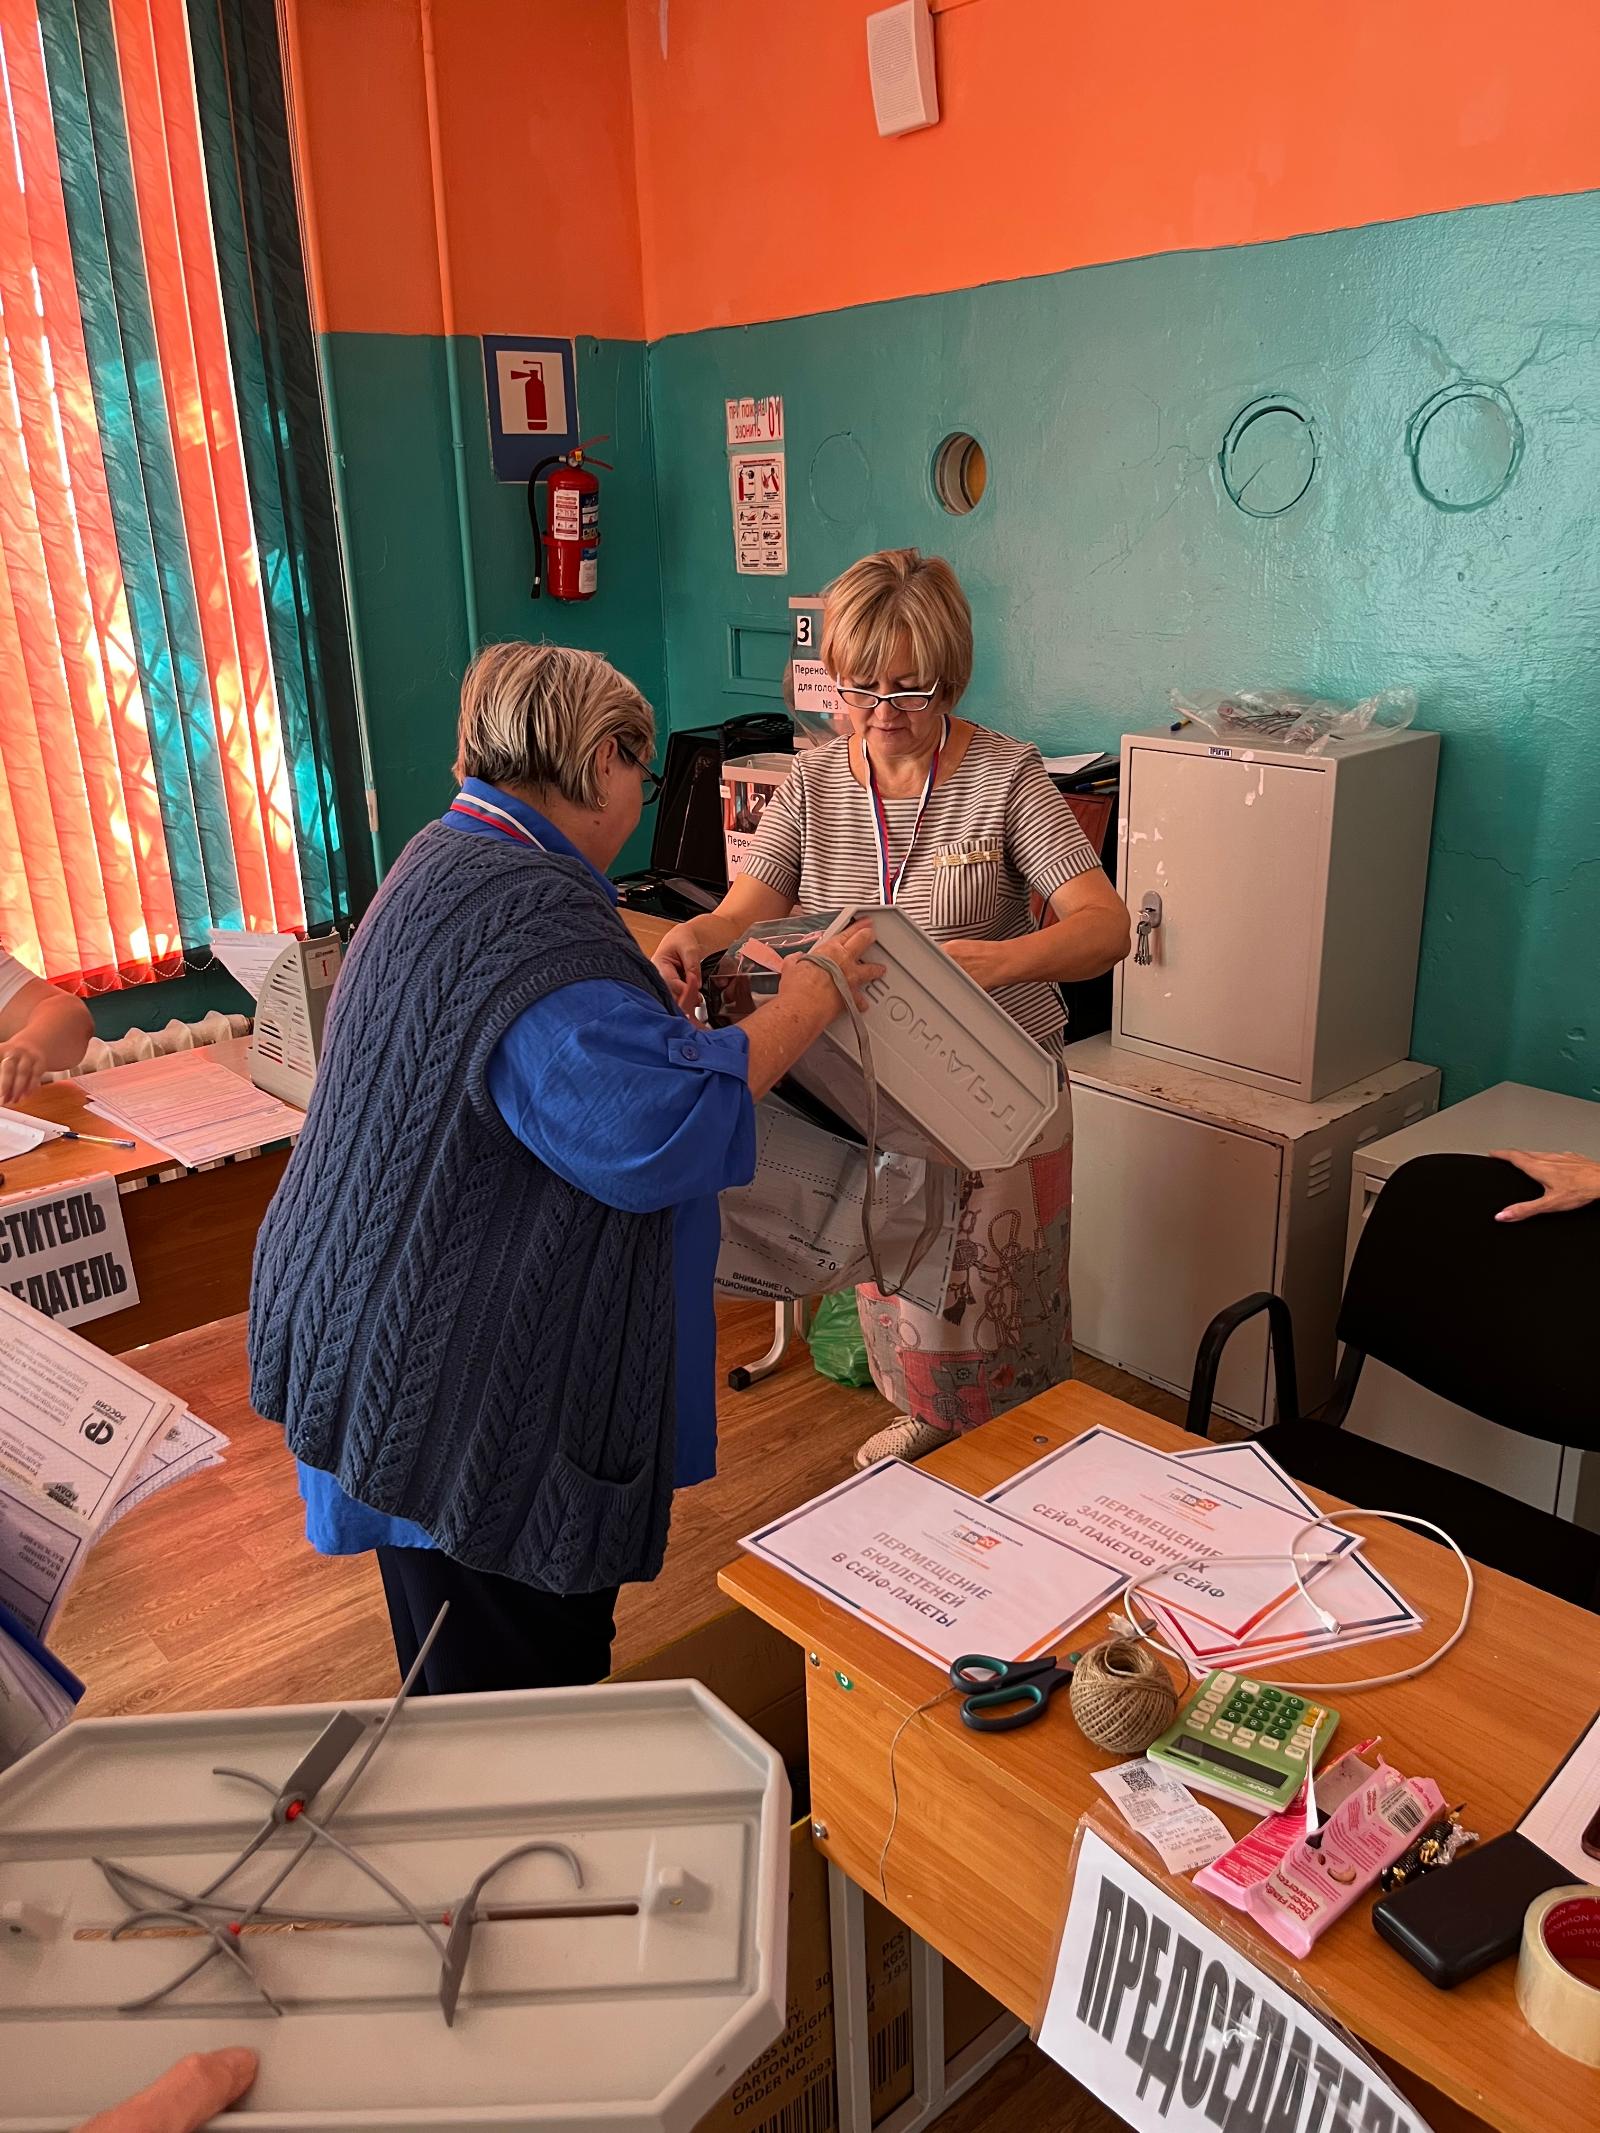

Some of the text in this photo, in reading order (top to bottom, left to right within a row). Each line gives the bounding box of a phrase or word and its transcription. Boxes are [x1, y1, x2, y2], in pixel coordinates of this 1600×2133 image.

[735, 424, 762, 439] ЗВОНИТЬ
[769, 401, 781, 438] 01
[797, 617, 810, 643] 3
[798, 683, 813, 693] для
[822, 699, 833, 709] №
[750, 793, 765, 815] 2
[731, 854, 743, 863] дл
[0, 1252, 128, 1320] ДАТЕЛЬ
[732, 1271, 783, 1291] ВНИМАНИЕ!
[95, 1399, 127, 1421] РОССИЯ
[54, 1482, 79, 1501] ЛЮДИ
[1094, 1495, 1224, 1559] ПЕРЕМЕЩЕНИЕ
[1032, 1502, 1156, 1567] СЕЙФ-ПАКЕТОВ
[1173, 1572, 1226, 1598] СЕЙФ
[861, 1546, 967, 1609] БЮЛЛЕТЕНЕЙ
[873, 1531, 992, 1600] ПЕРЕМЕЩЕНИЕ
[831, 1552, 958, 1628] В СЕЙФ-ПАКЕТЫ
[882, 1930, 904, 1956] PCS
[883, 1945, 905, 1971] KGS
[1076, 1875, 1412, 2133] ПРЕДСЕДАТ
[786, 2009, 805, 2029] TY:
[732, 2030, 822, 2101] CARTON NO.:
[744, 2049, 778, 2075] OSS
[733, 2052, 815, 2116] ORDER NO.:
